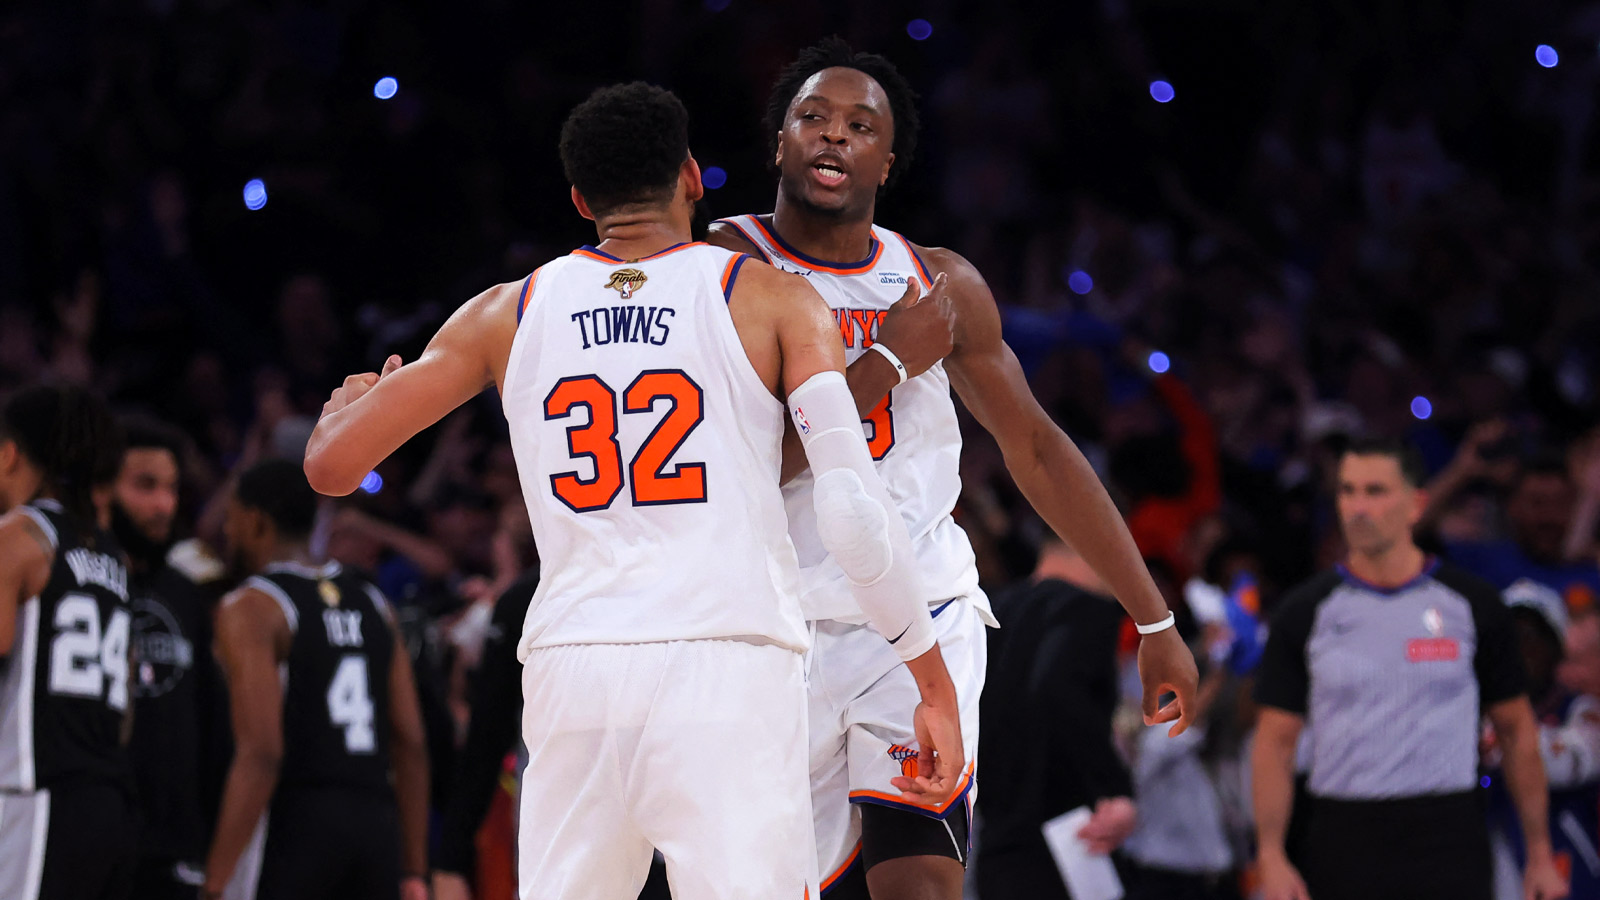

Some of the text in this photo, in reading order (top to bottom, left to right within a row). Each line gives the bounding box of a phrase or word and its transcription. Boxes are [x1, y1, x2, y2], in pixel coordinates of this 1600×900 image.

[608, 271, 646, 286] Finals
[571, 305, 676, 350] TOWNS
[543, 368, 708, 513] 32
[51, 592, 130, 711] 24
[327, 655, 375, 752] 4
